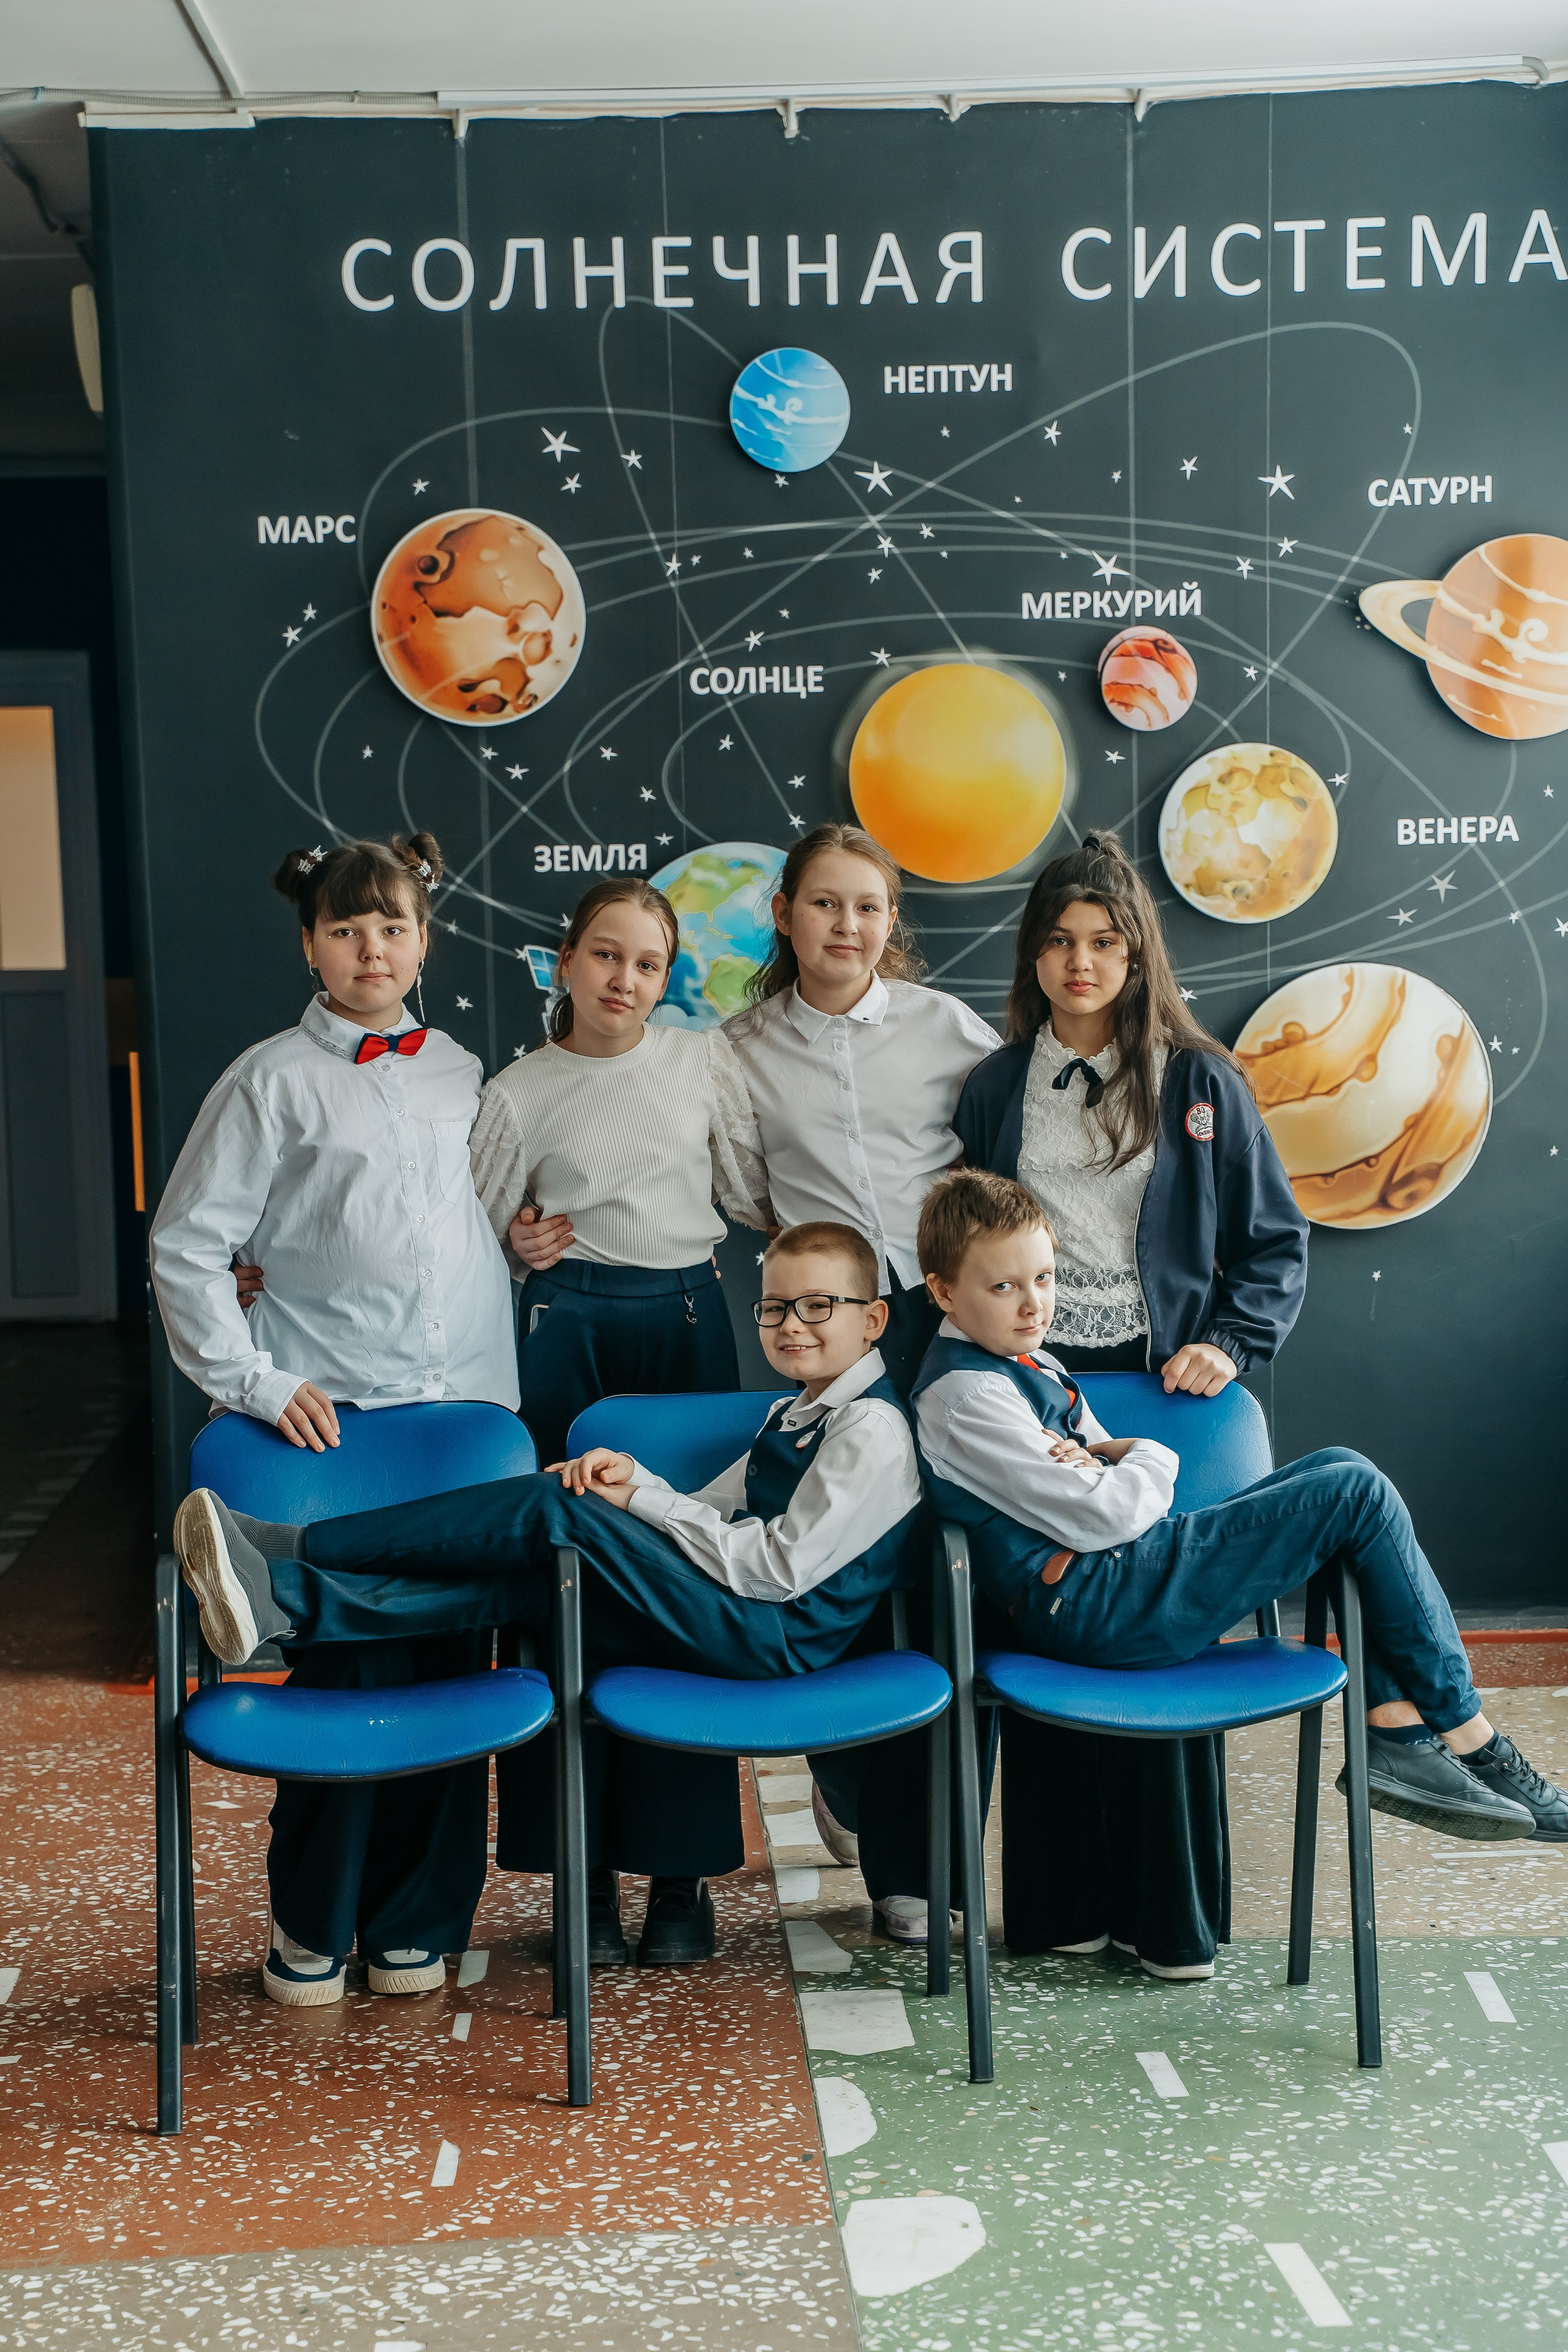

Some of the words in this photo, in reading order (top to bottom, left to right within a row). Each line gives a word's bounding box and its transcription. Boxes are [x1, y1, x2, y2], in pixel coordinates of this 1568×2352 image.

[341, 230, 984, 312] СОЛНЕЧНАЯ
[1060, 208, 1568, 301] СИСТЕМА
[883, 363, 1014, 394] НЕПТУН
[1367, 474, 1493, 508] САТУРН
[257, 514, 356, 544] МАРС
[1020, 581, 1203, 620] МЕРКУРИЙ
[689, 665, 825, 699] СОЛНЦЕ
[1396, 814, 1520, 846] ВЕНЕРА
[533, 843, 648, 873] ЗЕМЛЯ
[1196, 1106, 1205, 1115] 80
